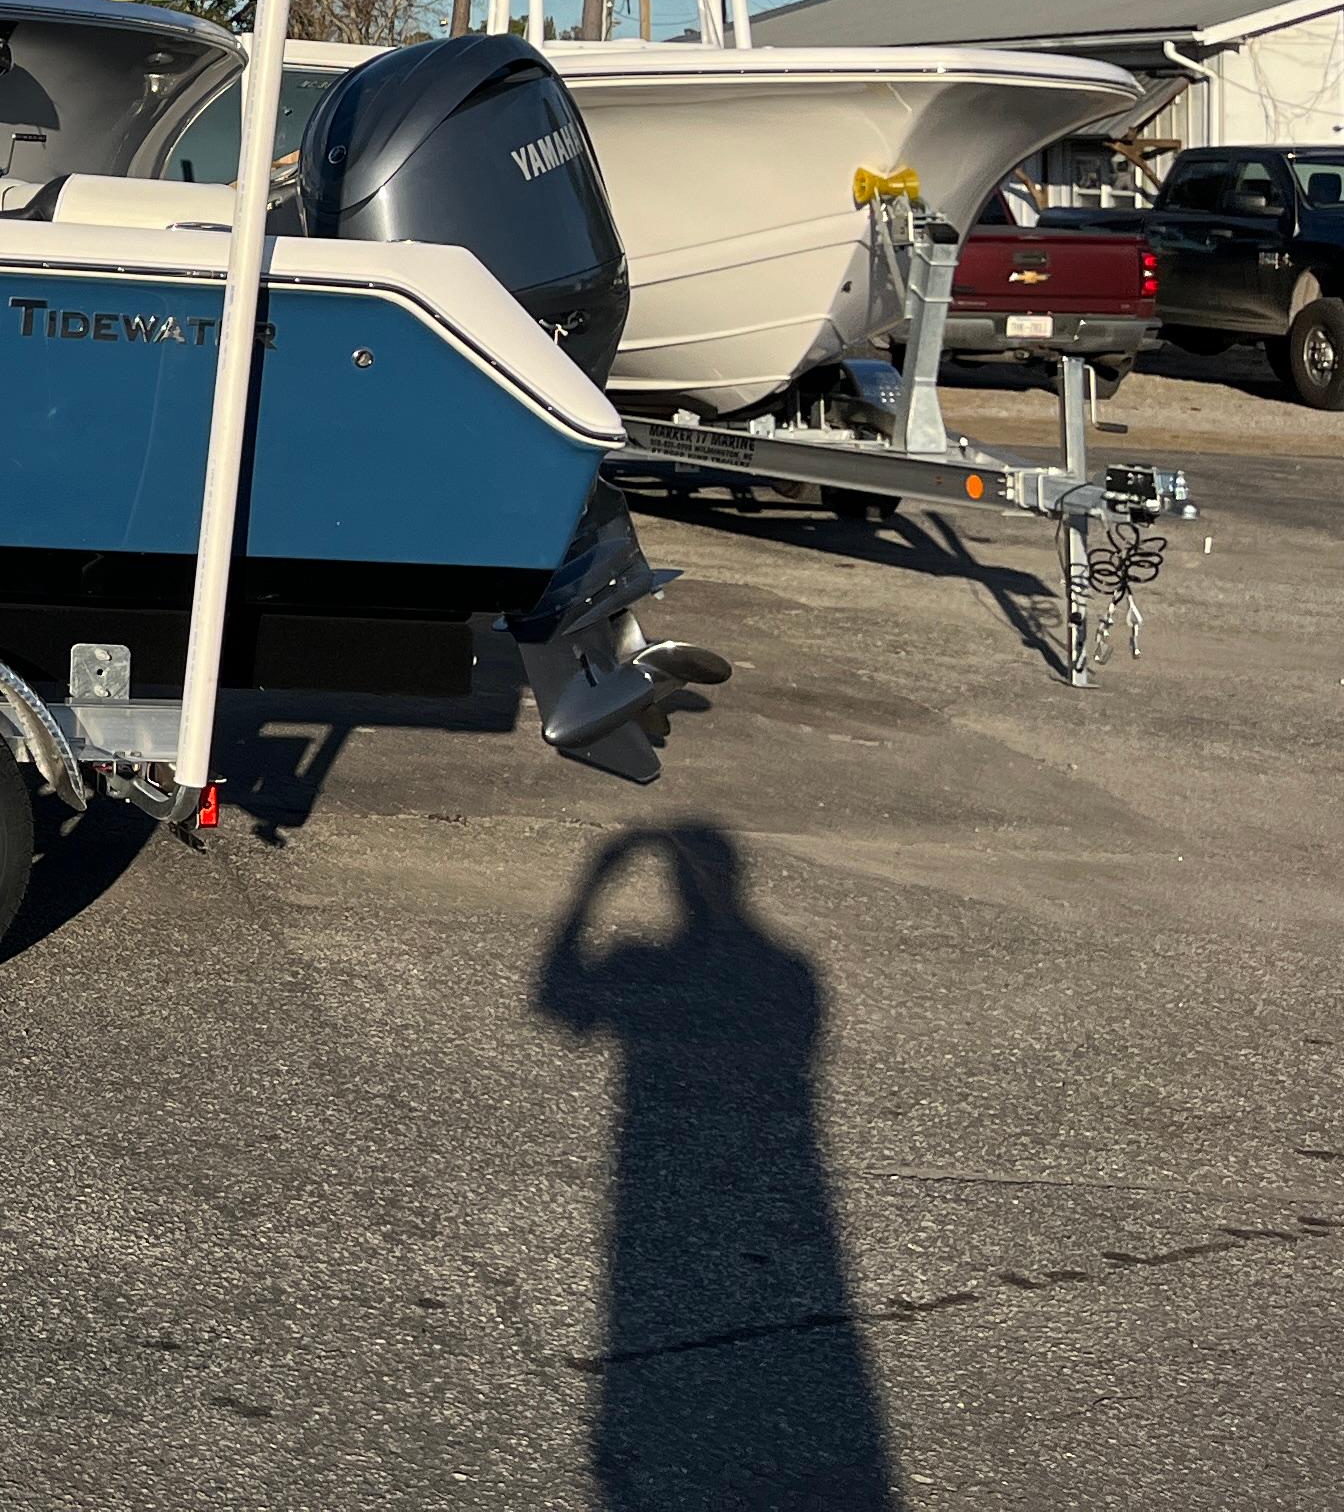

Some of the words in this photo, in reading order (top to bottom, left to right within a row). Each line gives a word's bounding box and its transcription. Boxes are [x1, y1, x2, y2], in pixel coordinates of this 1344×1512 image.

[510, 122, 584, 181] YAMAHA
[8, 296, 278, 351] TIDEWATR
[649, 425, 693, 443] MARKER
[709, 432, 755, 451] MARINE
